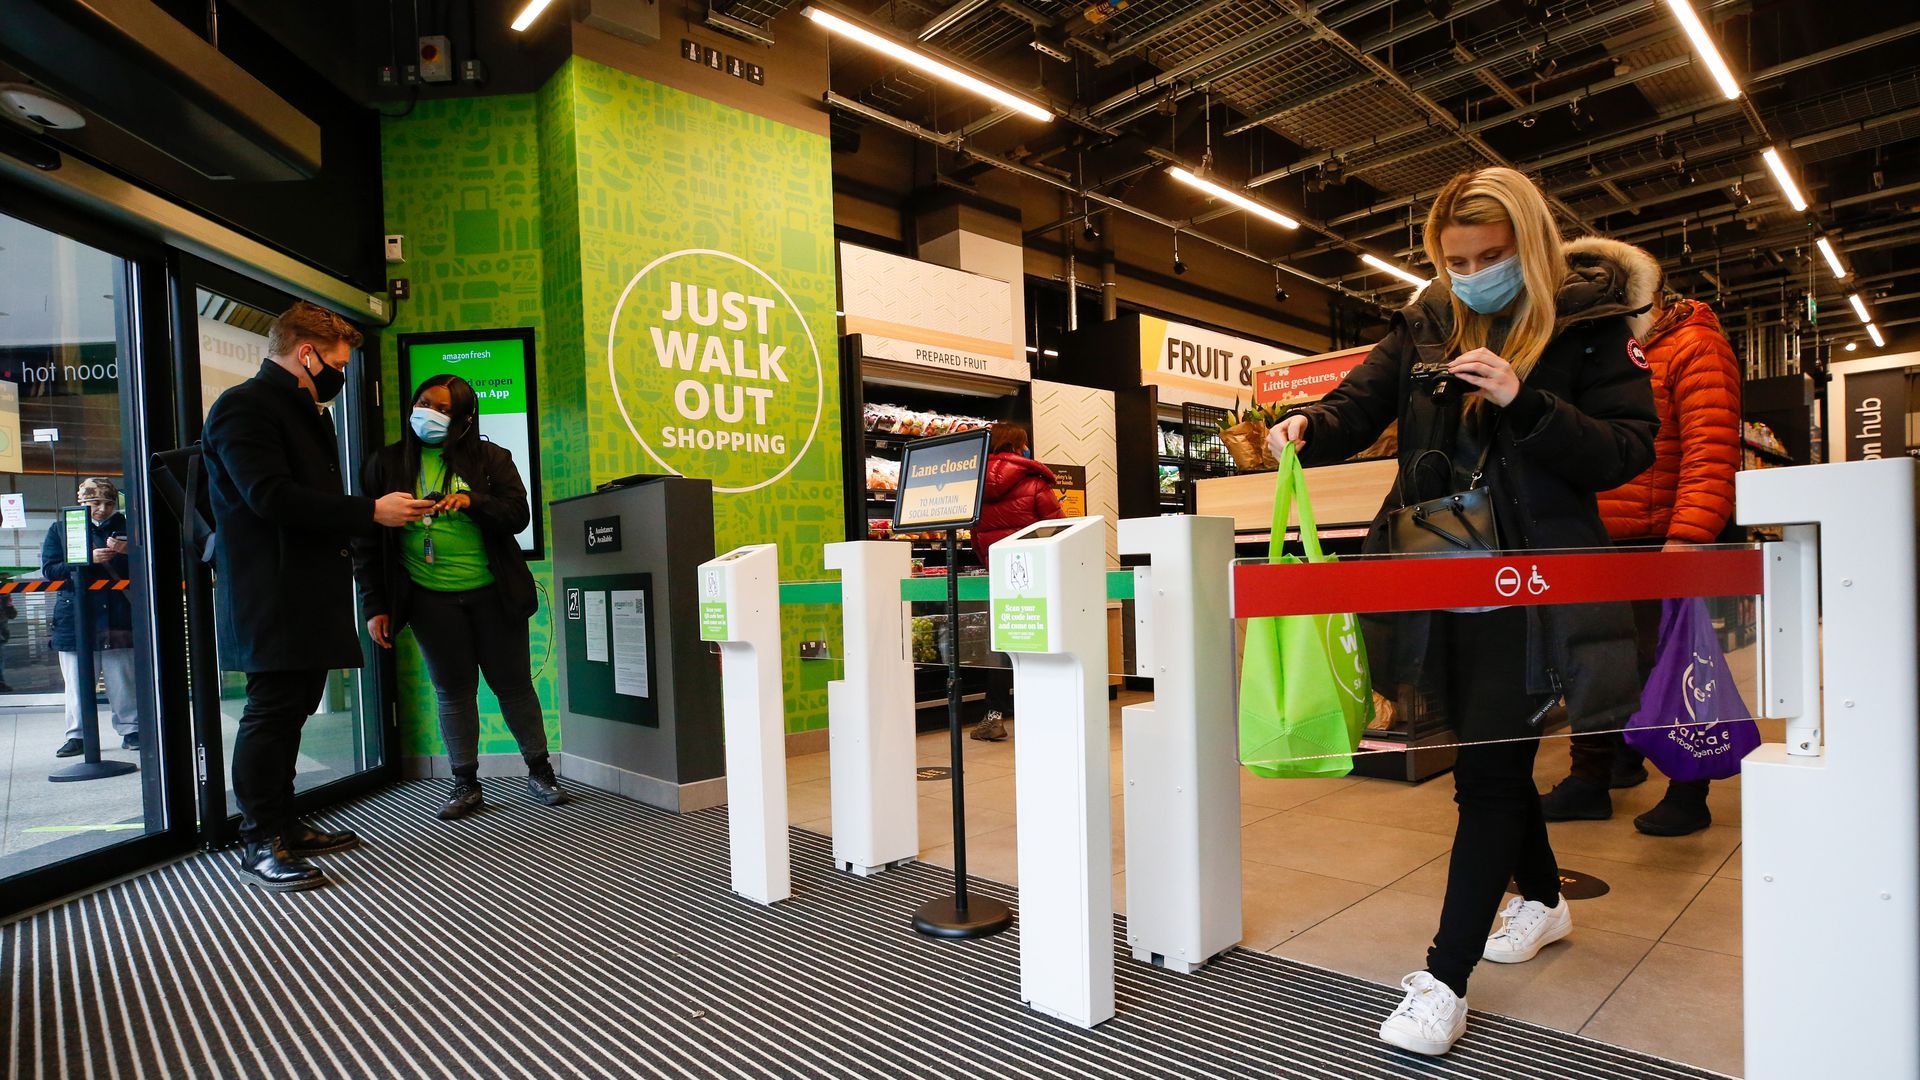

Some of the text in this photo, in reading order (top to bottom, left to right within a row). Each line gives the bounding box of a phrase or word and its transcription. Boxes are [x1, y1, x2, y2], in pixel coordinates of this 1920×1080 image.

[662, 281, 775, 335] JUST
[650, 326, 789, 383] WALK
[916, 349, 987, 371] PREPARED FRUIT
[1167, 337, 1251, 386] FRUIT &
[22, 361, 56, 383] hot
[488, 378, 513, 388] open
[1263, 378, 1290, 393] Little
[1291, 371, 1338, 390] gestures,
[489, 389, 510, 400] App
[674, 379, 773, 425] OUT
[1855, 397, 1882, 439] hub
[662, 426, 785, 455] SHOPPING
[911, 454, 978, 479] Lane closed
[908, 504, 967, 519] SOCIAL DISTANCING
[920, 495, 959, 507] TO MAINTAIN
[1001, 613, 1041, 622] QR code here
[1020, 605, 1035, 613] your
[998, 622, 1010, 630] and
